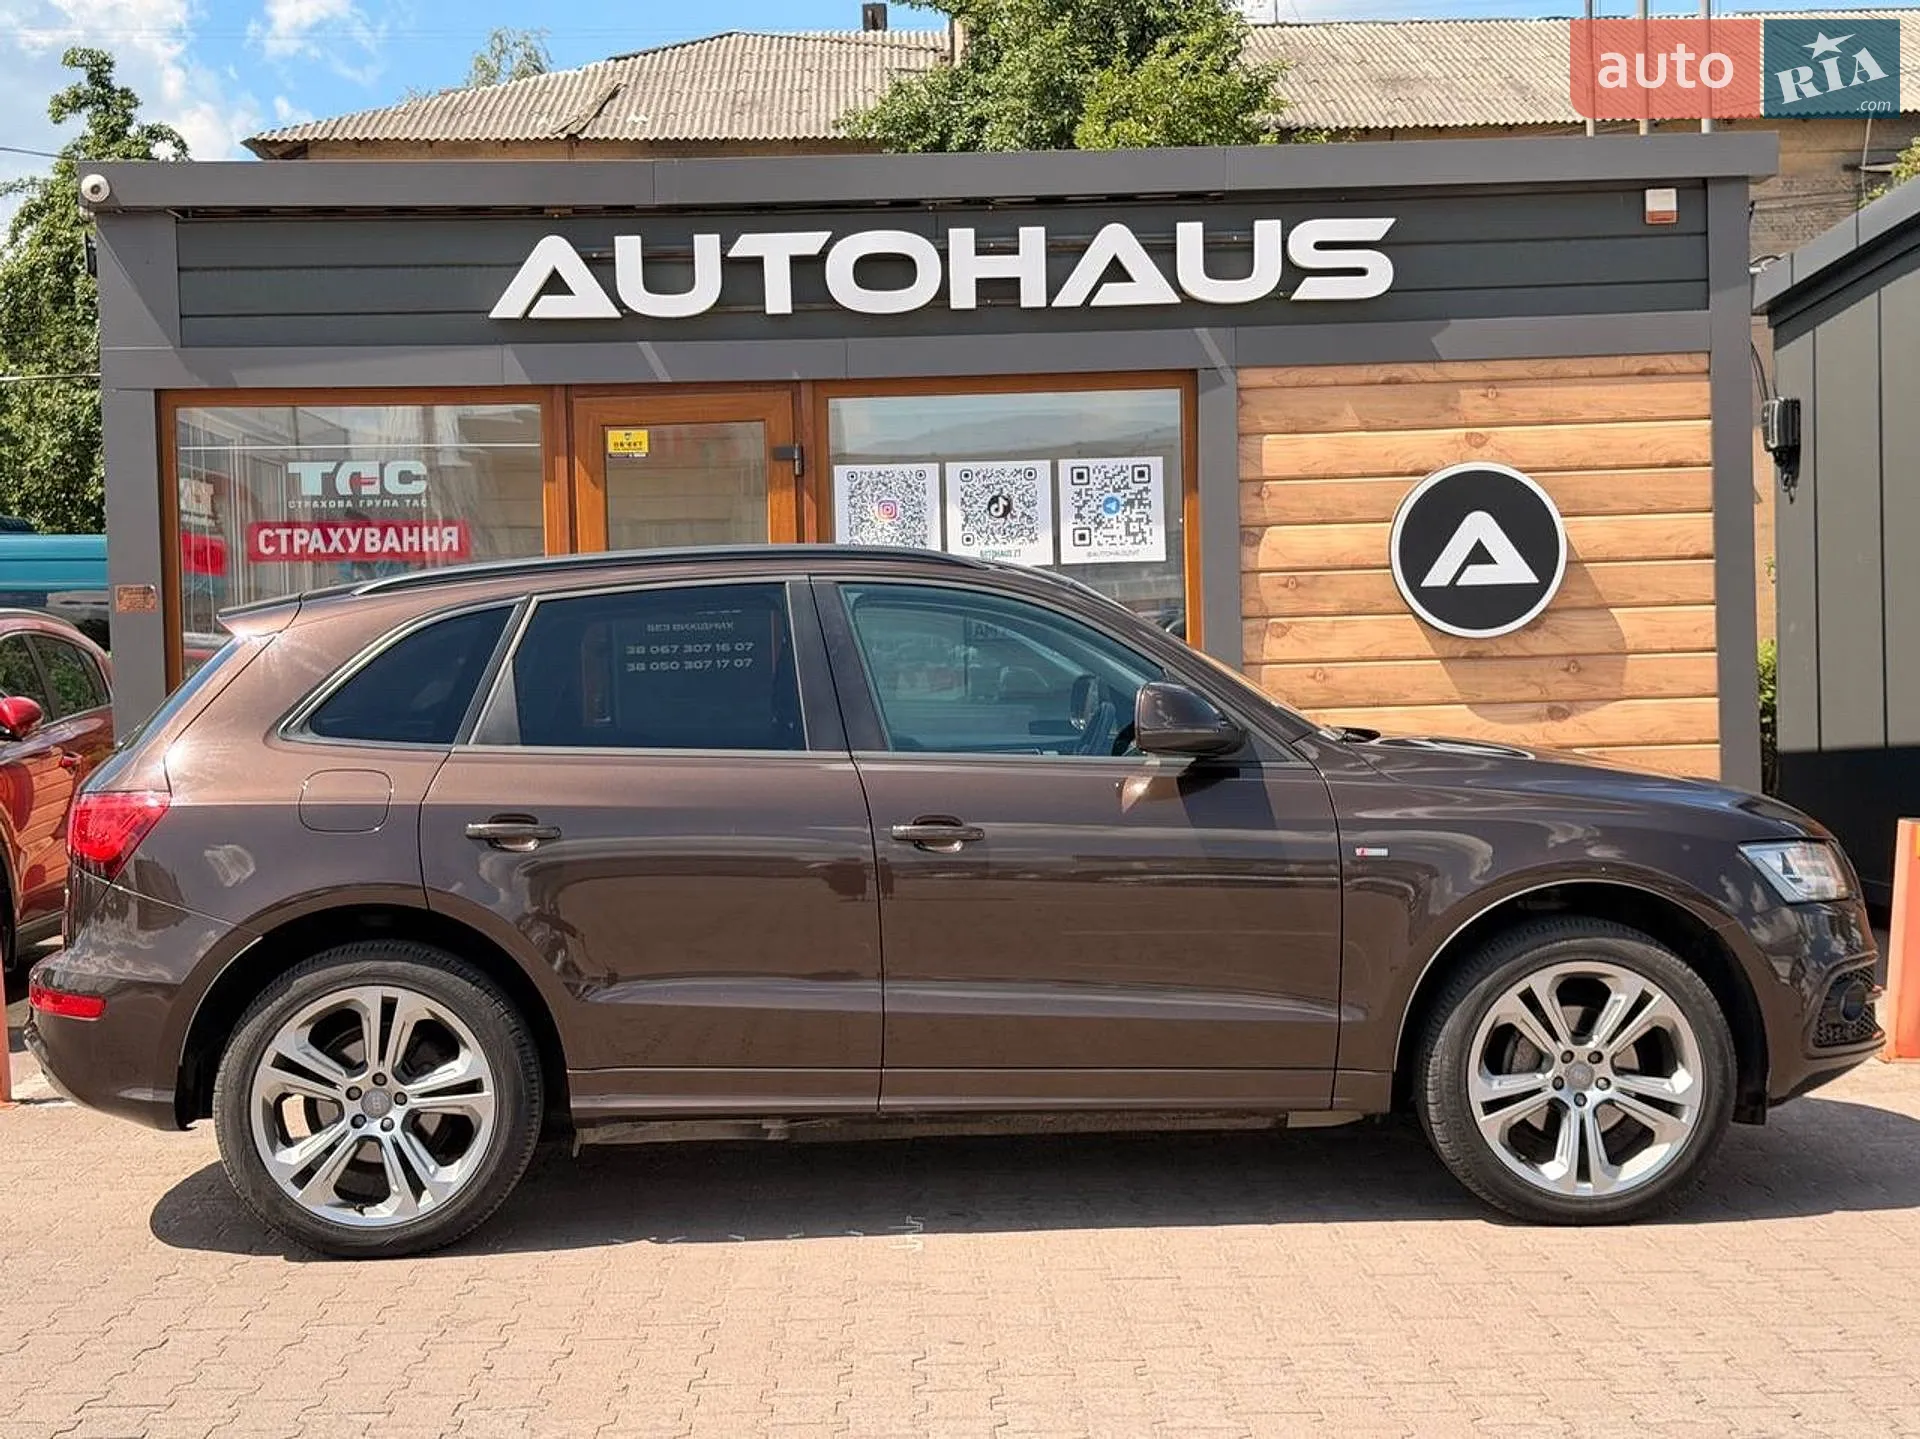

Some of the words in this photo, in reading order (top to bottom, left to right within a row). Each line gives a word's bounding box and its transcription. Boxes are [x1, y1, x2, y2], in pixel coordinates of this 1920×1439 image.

[488, 217, 1398, 320] AUTOHAUS
[287, 500, 353, 509] СТРАХОВА
[359, 500, 399, 509] ГРУПА
[257, 526, 460, 555] СТРАХУВАННЯ
[649, 644, 680, 654] 067
[683, 643, 713, 653] 307
[715, 642, 731, 652] 16
[734, 641, 755, 651] 07
[649, 661, 680, 670] 050
[683, 660, 713, 670] 307
[716, 659, 731, 668] 17
[733, 658, 753, 668] 07
